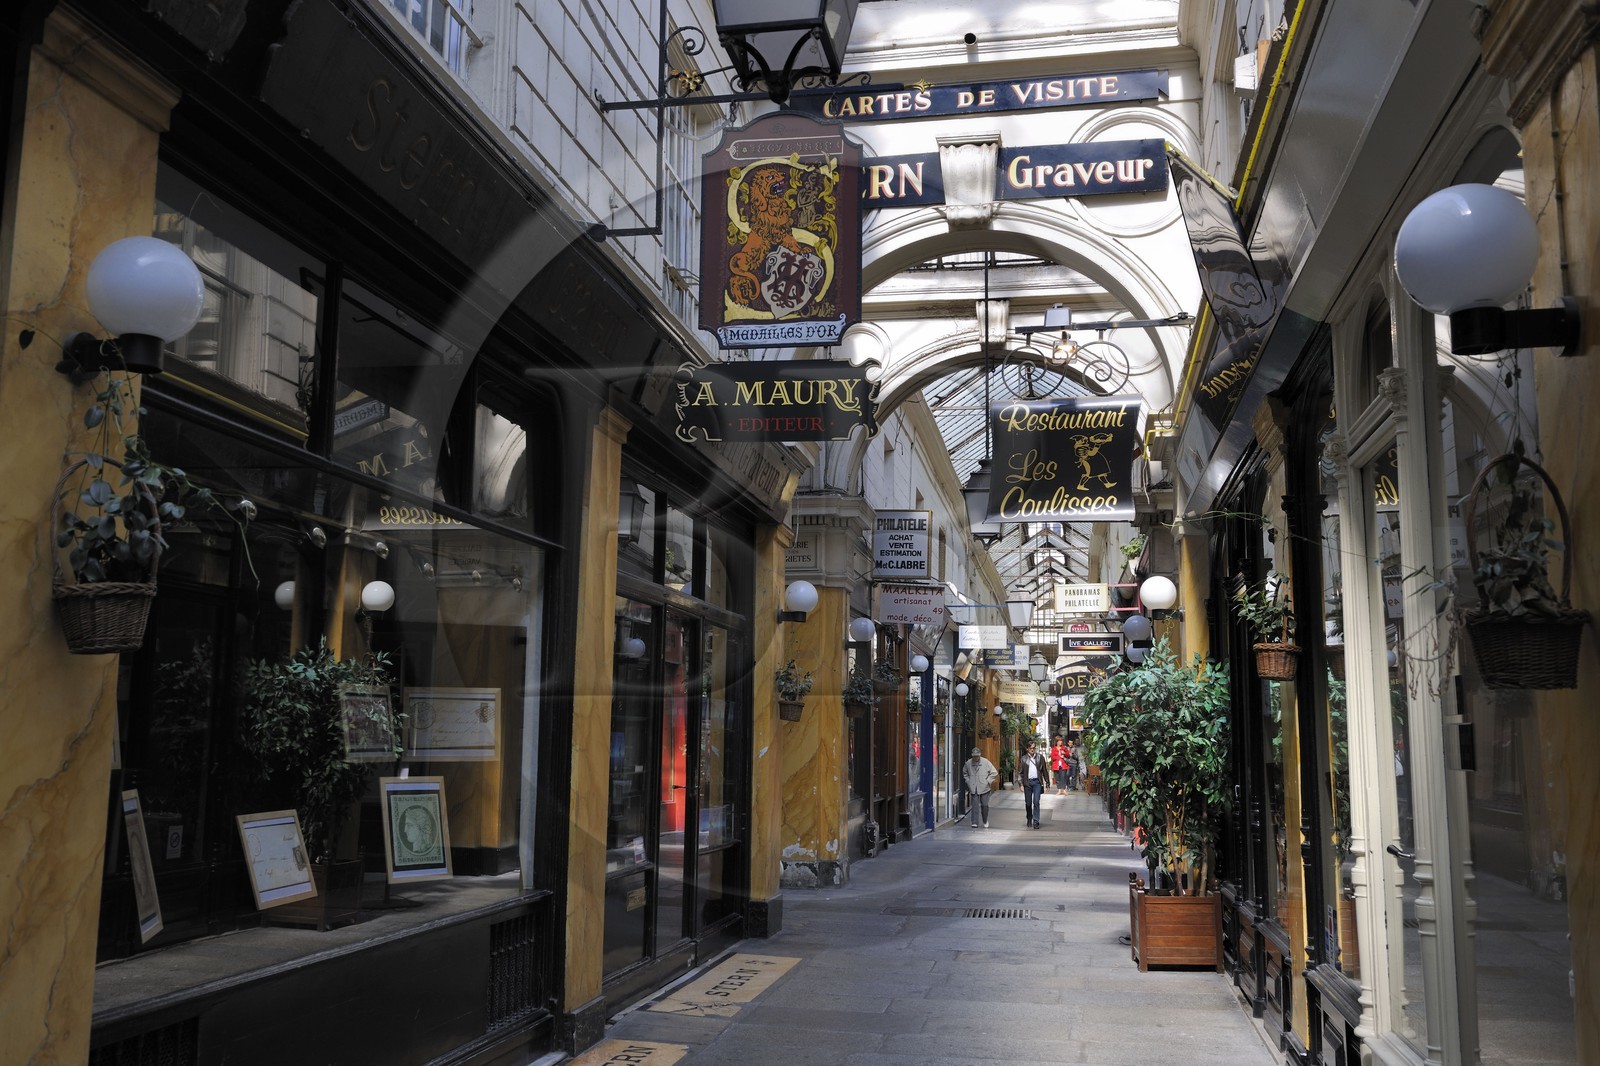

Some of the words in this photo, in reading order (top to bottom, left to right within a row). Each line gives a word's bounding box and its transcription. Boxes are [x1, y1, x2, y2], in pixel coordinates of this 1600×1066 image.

[823, 92, 931, 118] CARTES
[957, 89, 995, 108] DE
[862, 162, 924, 199] RN
[1007, 154, 1154, 189] Graveur
[806, 324, 840, 340] D'OR
[734, 378, 862, 417] MAURY
[999, 401, 1127, 432] Restaurant
[1005, 448, 1058, 483] Les
[1000, 485, 1118, 520] Coulisses
[880, 549, 922, 557] ESTIMATION
[882, 585, 944, 596] MAALKITA
[893, 597, 932, 606] artisanat
[1065, 588, 1101, 597] PANORAMAS
[932, 607, 943, 615] 49
[704, 968, 762, 997] STERN
[601, 1045, 658, 1066] RN
